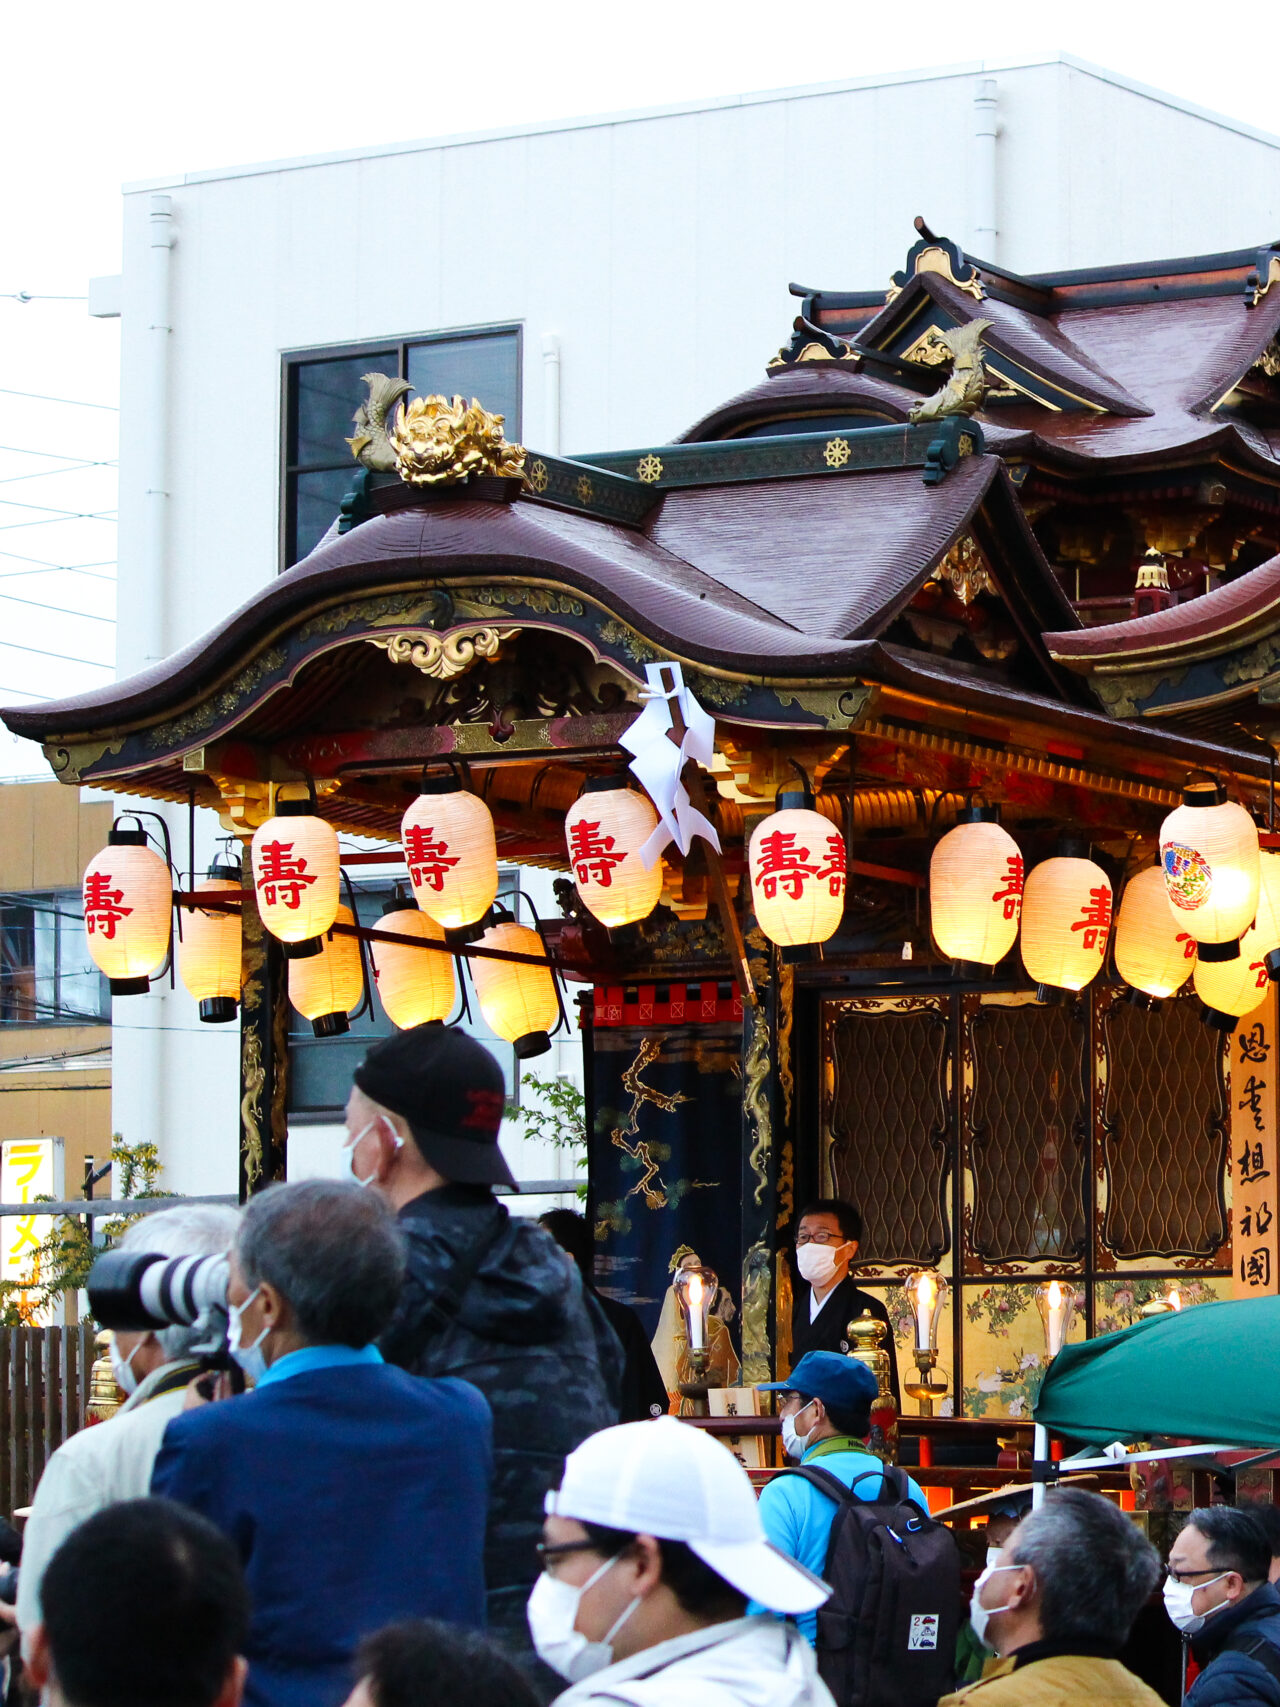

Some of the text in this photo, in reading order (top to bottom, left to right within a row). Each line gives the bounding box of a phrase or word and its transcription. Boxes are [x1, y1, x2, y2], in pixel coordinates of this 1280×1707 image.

[256, 840, 318, 909] 壽
[405, 824, 461, 891] 壽
[569, 819, 629, 887] 壽
[756, 830, 822, 900] 壽
[84, 871, 134, 940] 壽
